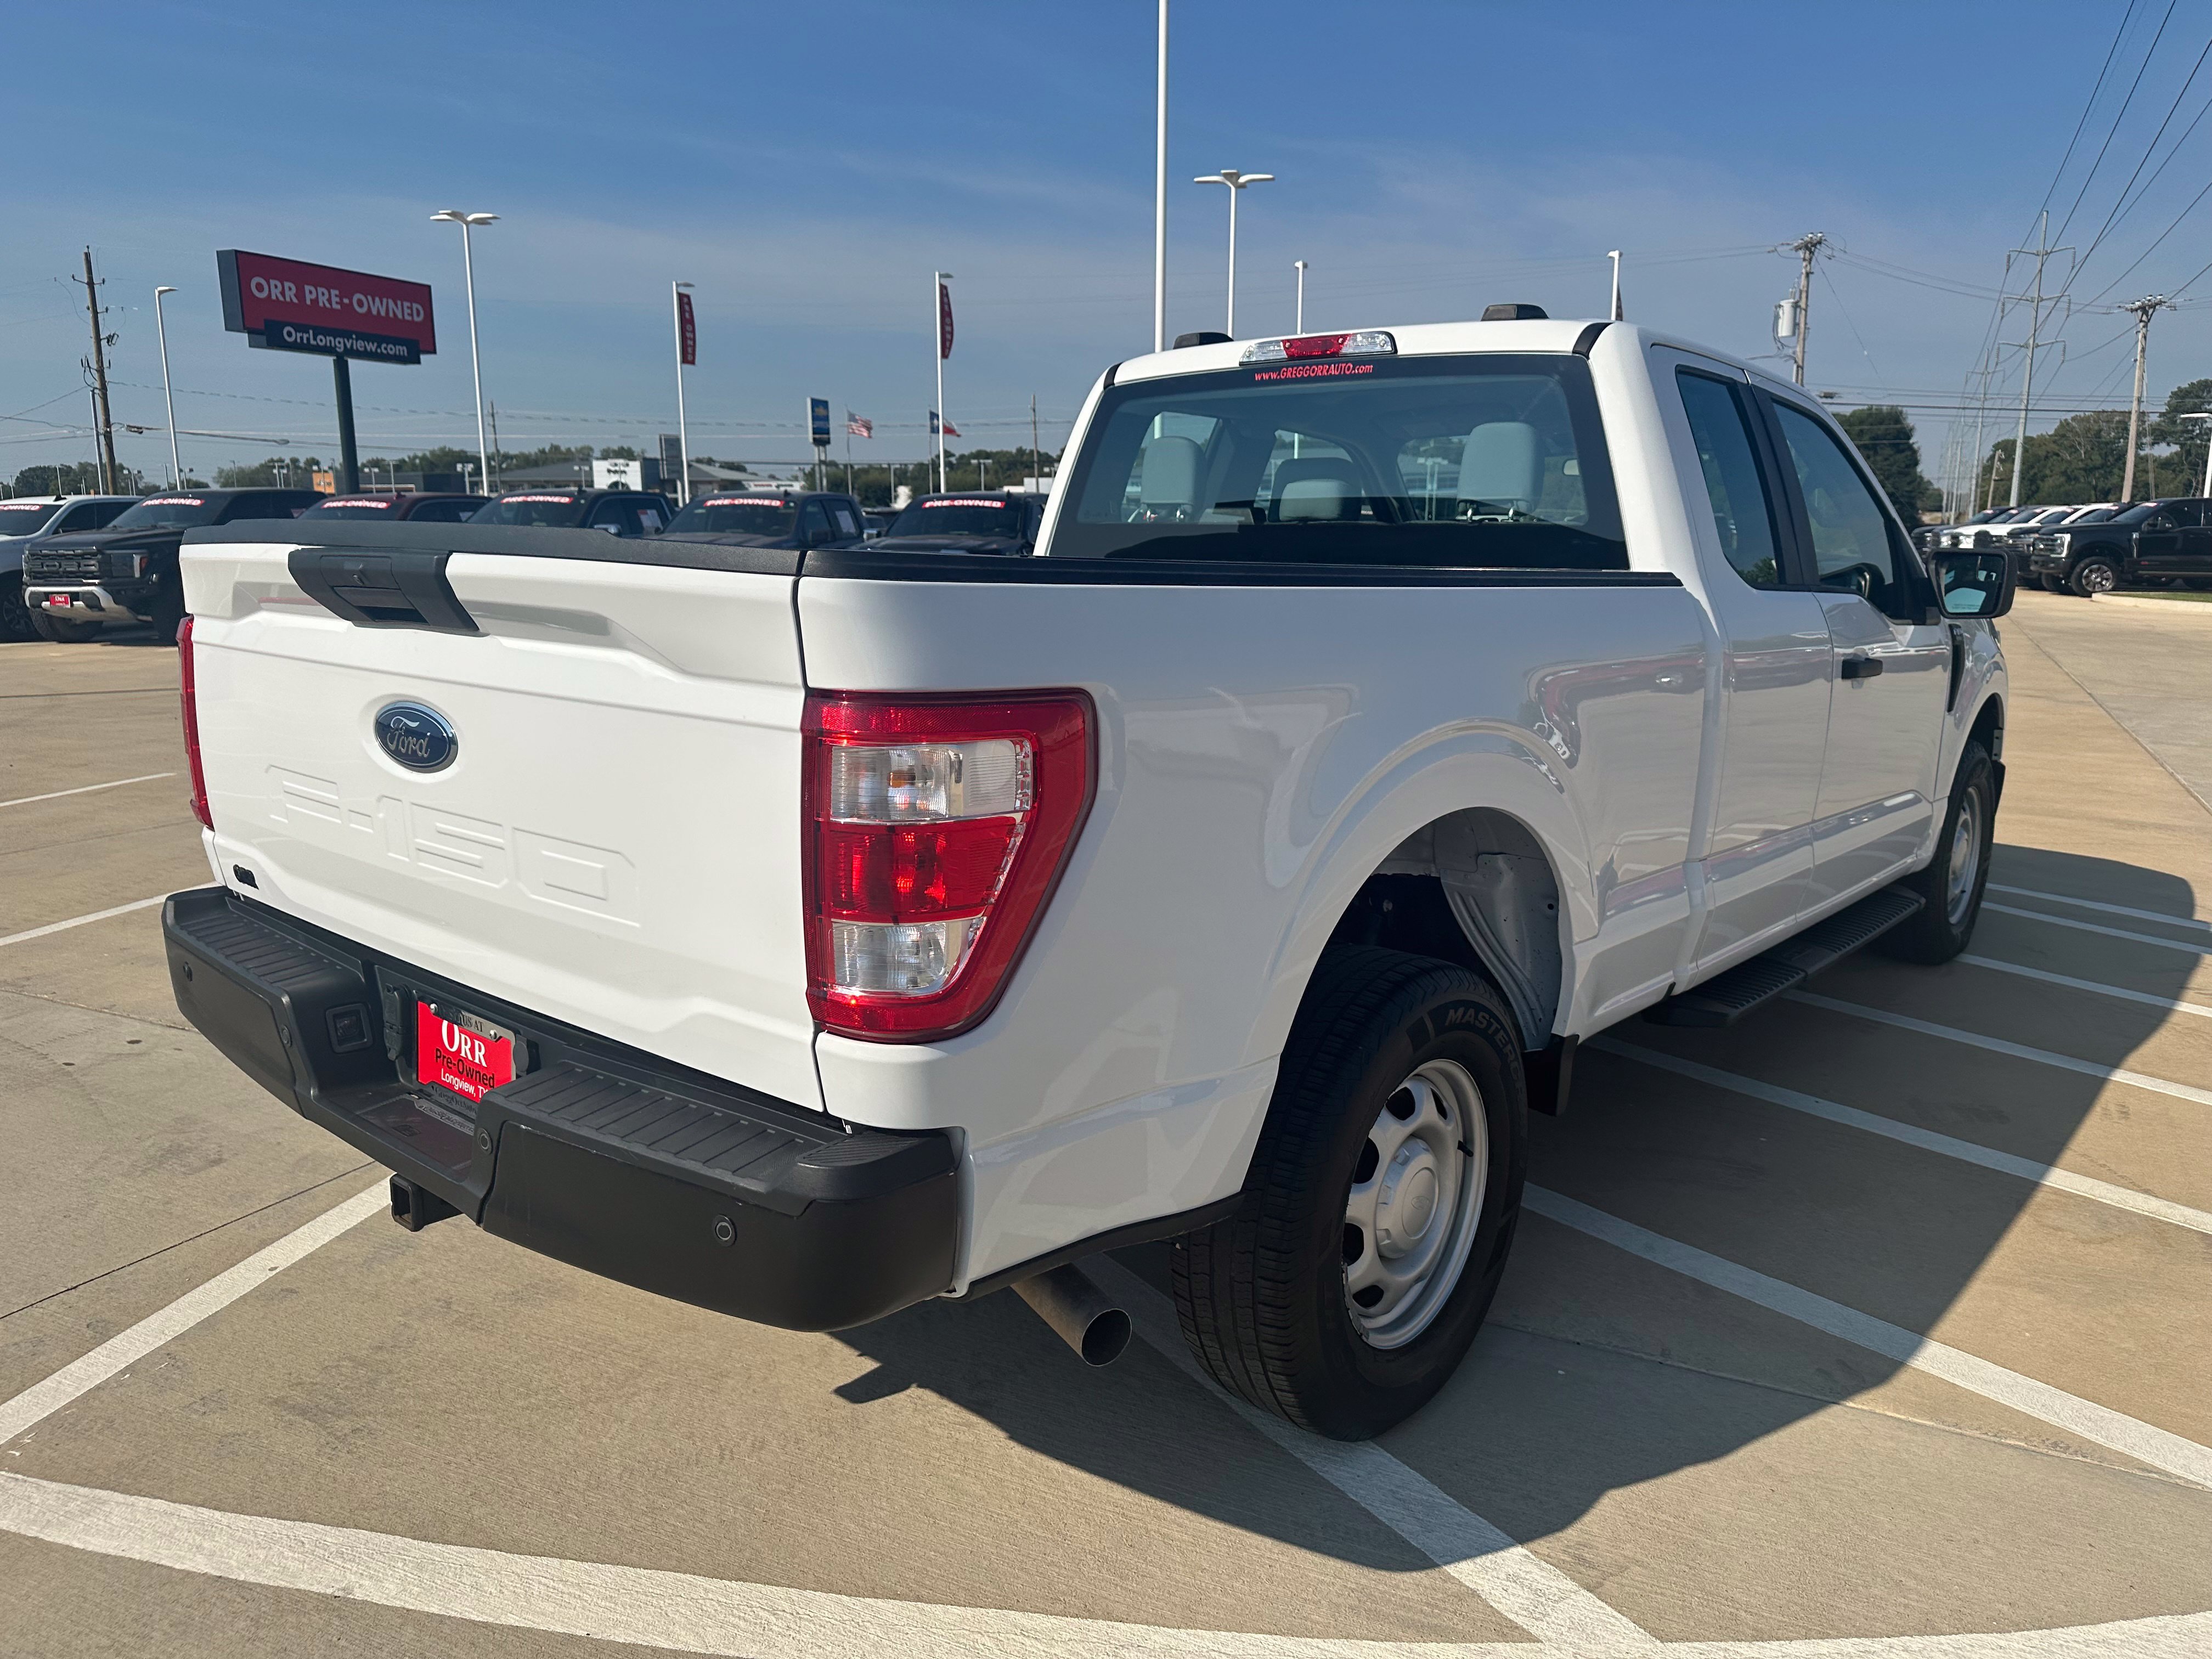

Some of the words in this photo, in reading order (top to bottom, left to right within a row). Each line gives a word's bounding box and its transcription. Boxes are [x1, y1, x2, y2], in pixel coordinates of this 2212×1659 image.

[250, 276, 298, 303] ORR
[304, 284, 425, 322] PRE-OWNED
[283, 325, 408, 357] OrrLongview.com
[1255, 363, 1373, 381] www.GREGGORRAUTO.com
[706, 498, 782, 507] PRE-OWNED
[924, 499, 1002, 508] PRE-OWNED
[387, 715, 431, 758] Ford
[266, 764, 642, 927] F-150
[441, 1019, 488, 1068] ORR
[435, 1047, 495, 1089] Pre-Owned
[441, 1068, 476, 1098] Longview,
